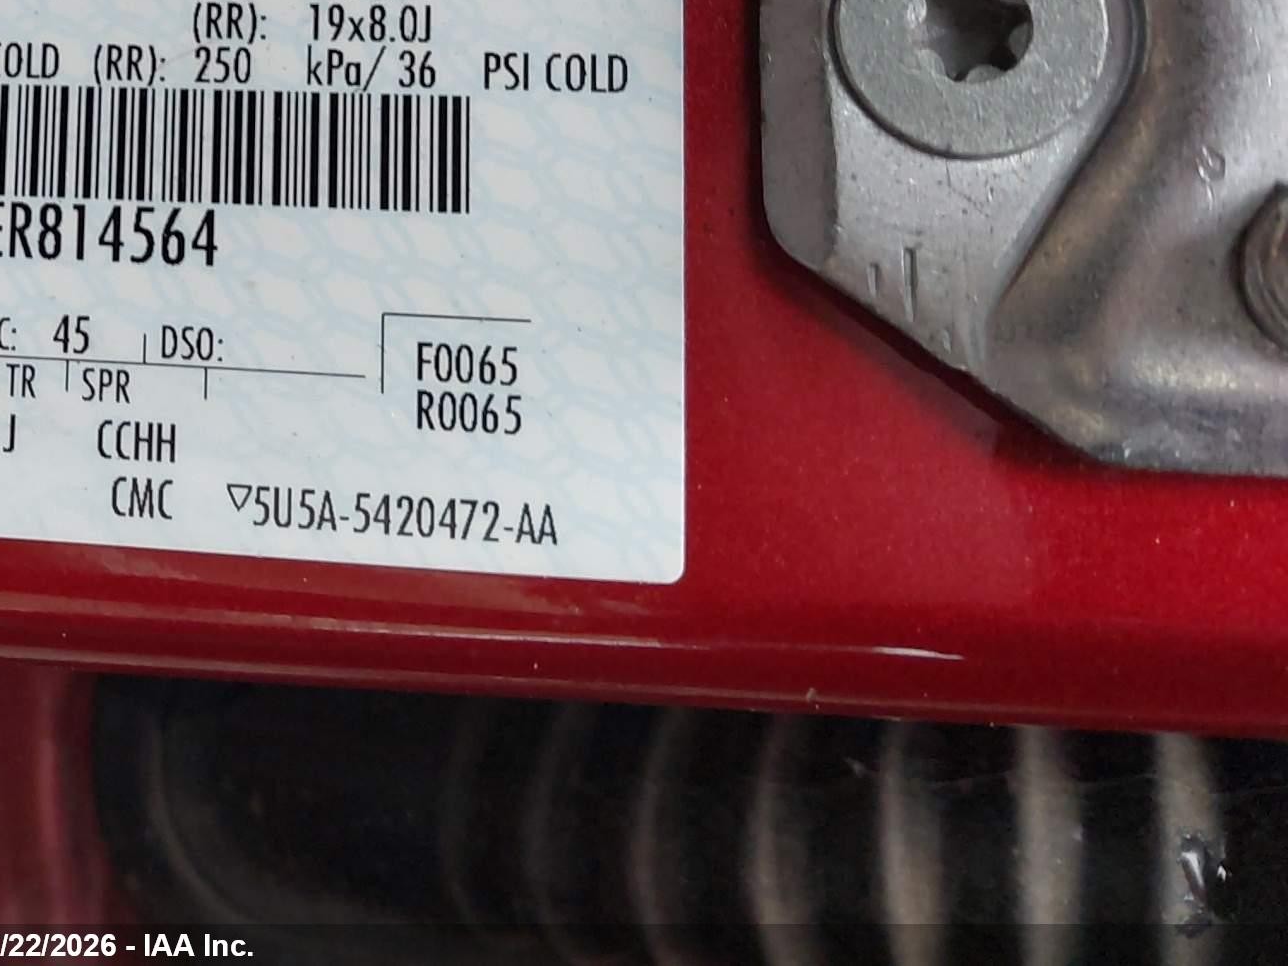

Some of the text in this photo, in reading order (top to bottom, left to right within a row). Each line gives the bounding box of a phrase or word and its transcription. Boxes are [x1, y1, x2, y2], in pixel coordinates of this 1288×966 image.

[193, 2, 431, 44] (RR): 19x8.0J
[94, 44, 165, 91] (RR):
[195, 46, 251, 84] 250
[307, 45, 386, 92] kPa/
[399, 50, 435, 88] 36
[484, 52, 529, 91] PSI
[546, 53, 628, 93] COLD
[53, 315, 90, 354] 45
[162, 325, 223, 361] DSO:
[6, 363, 35, 398] TR
[417, 342, 517, 386] F0065
[82, 368, 130, 404] SPR
[3, 414, 16, 452] J
[417, 390, 521, 434] R0065
[98, 420, 176, 463] CCHH
[112, 477, 173, 519] CMC
[253, 486, 557, 545] 5U5A-5420472-AA
